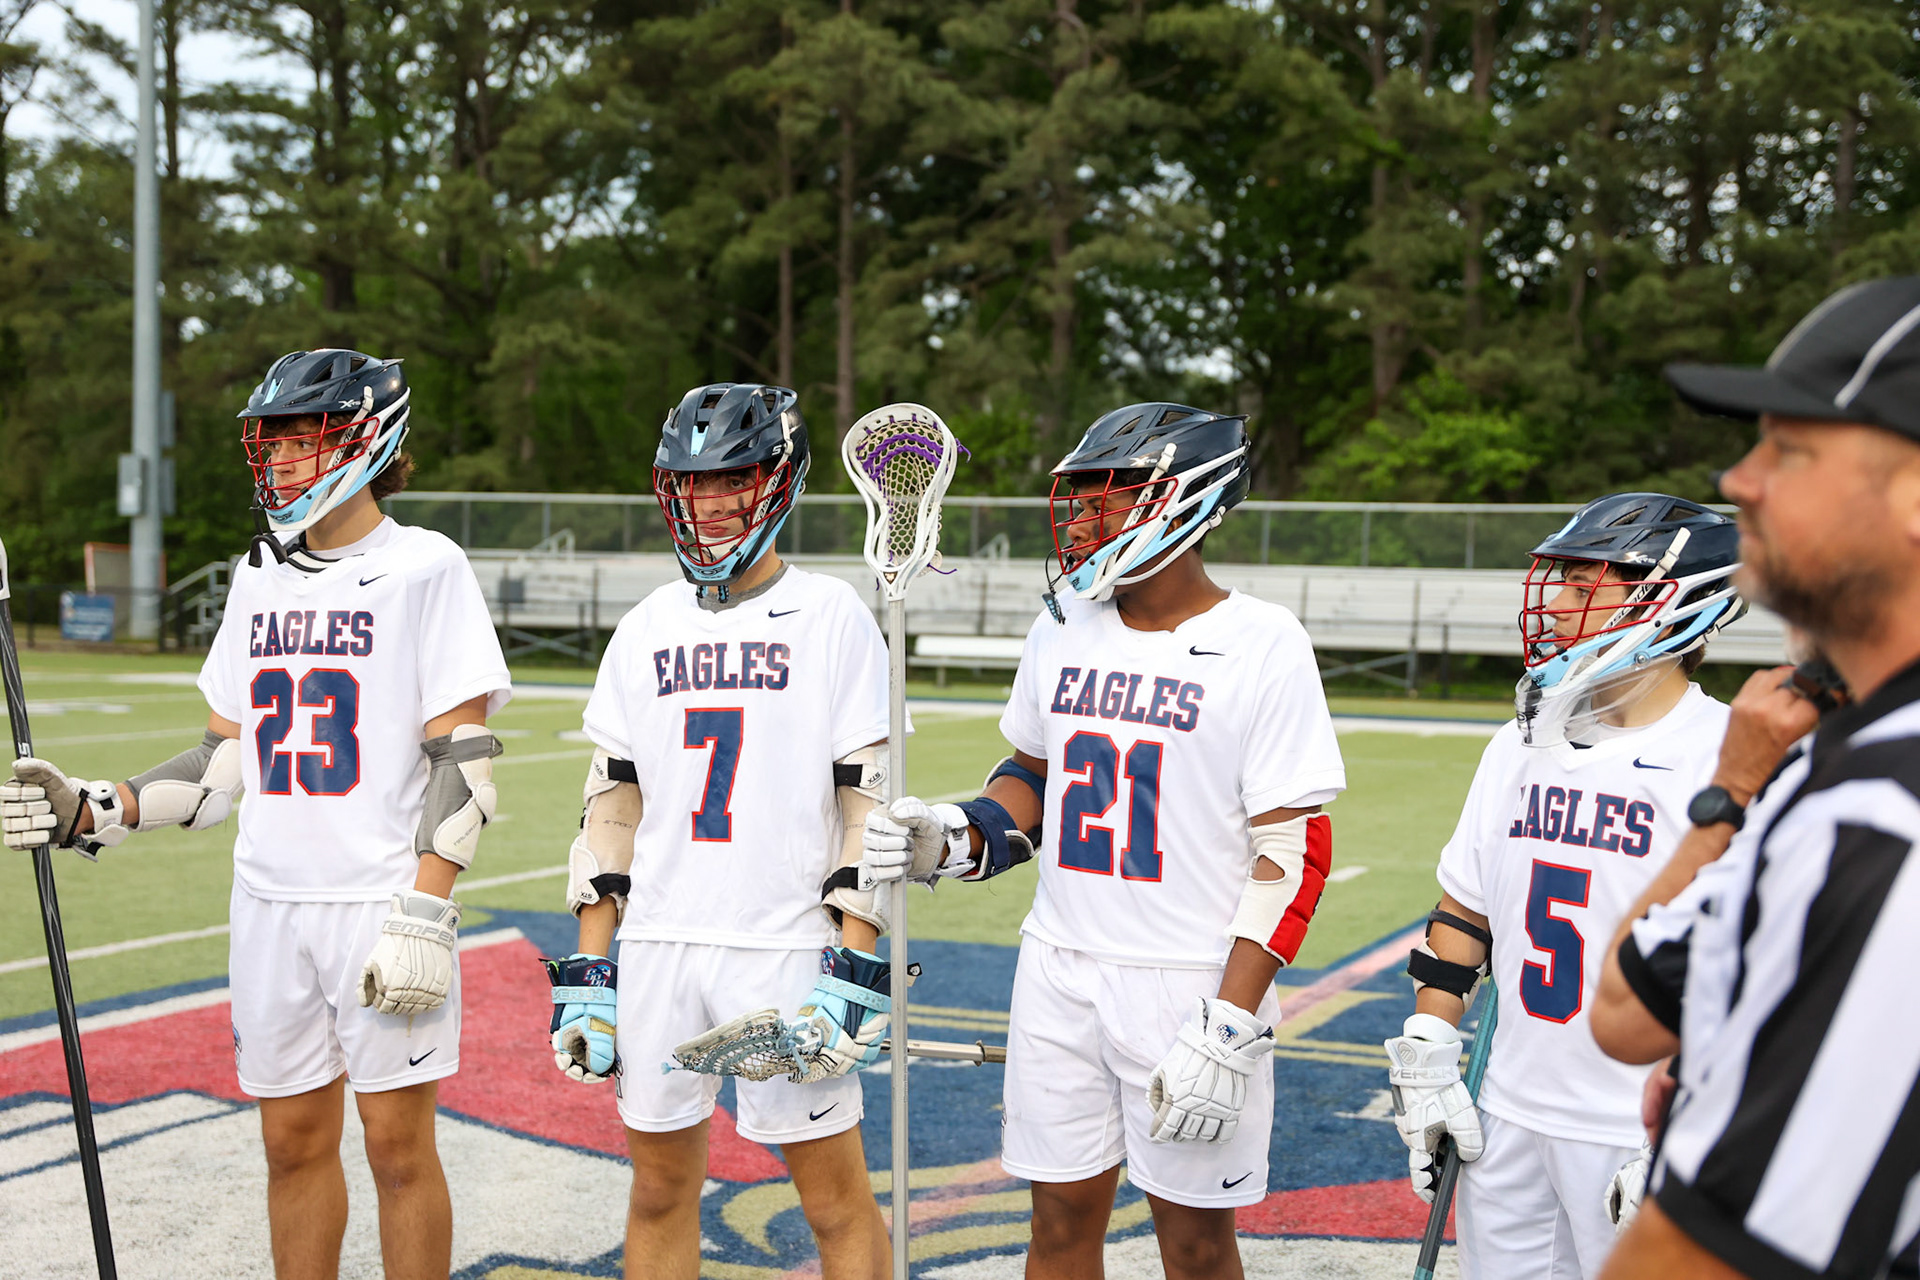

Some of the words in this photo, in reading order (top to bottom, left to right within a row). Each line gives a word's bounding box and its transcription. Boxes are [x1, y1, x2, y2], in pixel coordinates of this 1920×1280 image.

[250, 610, 374, 658] EAGLES
[653, 642, 790, 697] EAGLES
[1050, 667, 1205, 733] EAGLES
[250, 667, 361, 797] 23
[683, 707, 745, 843] 7
[867, 771, 881, 785] STX
[1057, 730, 1165, 883] 21
[864, 878, 873, 886] TX
[1520, 859, 1592, 1025] 5
[551, 988, 605, 1001] VERIK
[1389, 1066, 1456, 1080] VERIK
